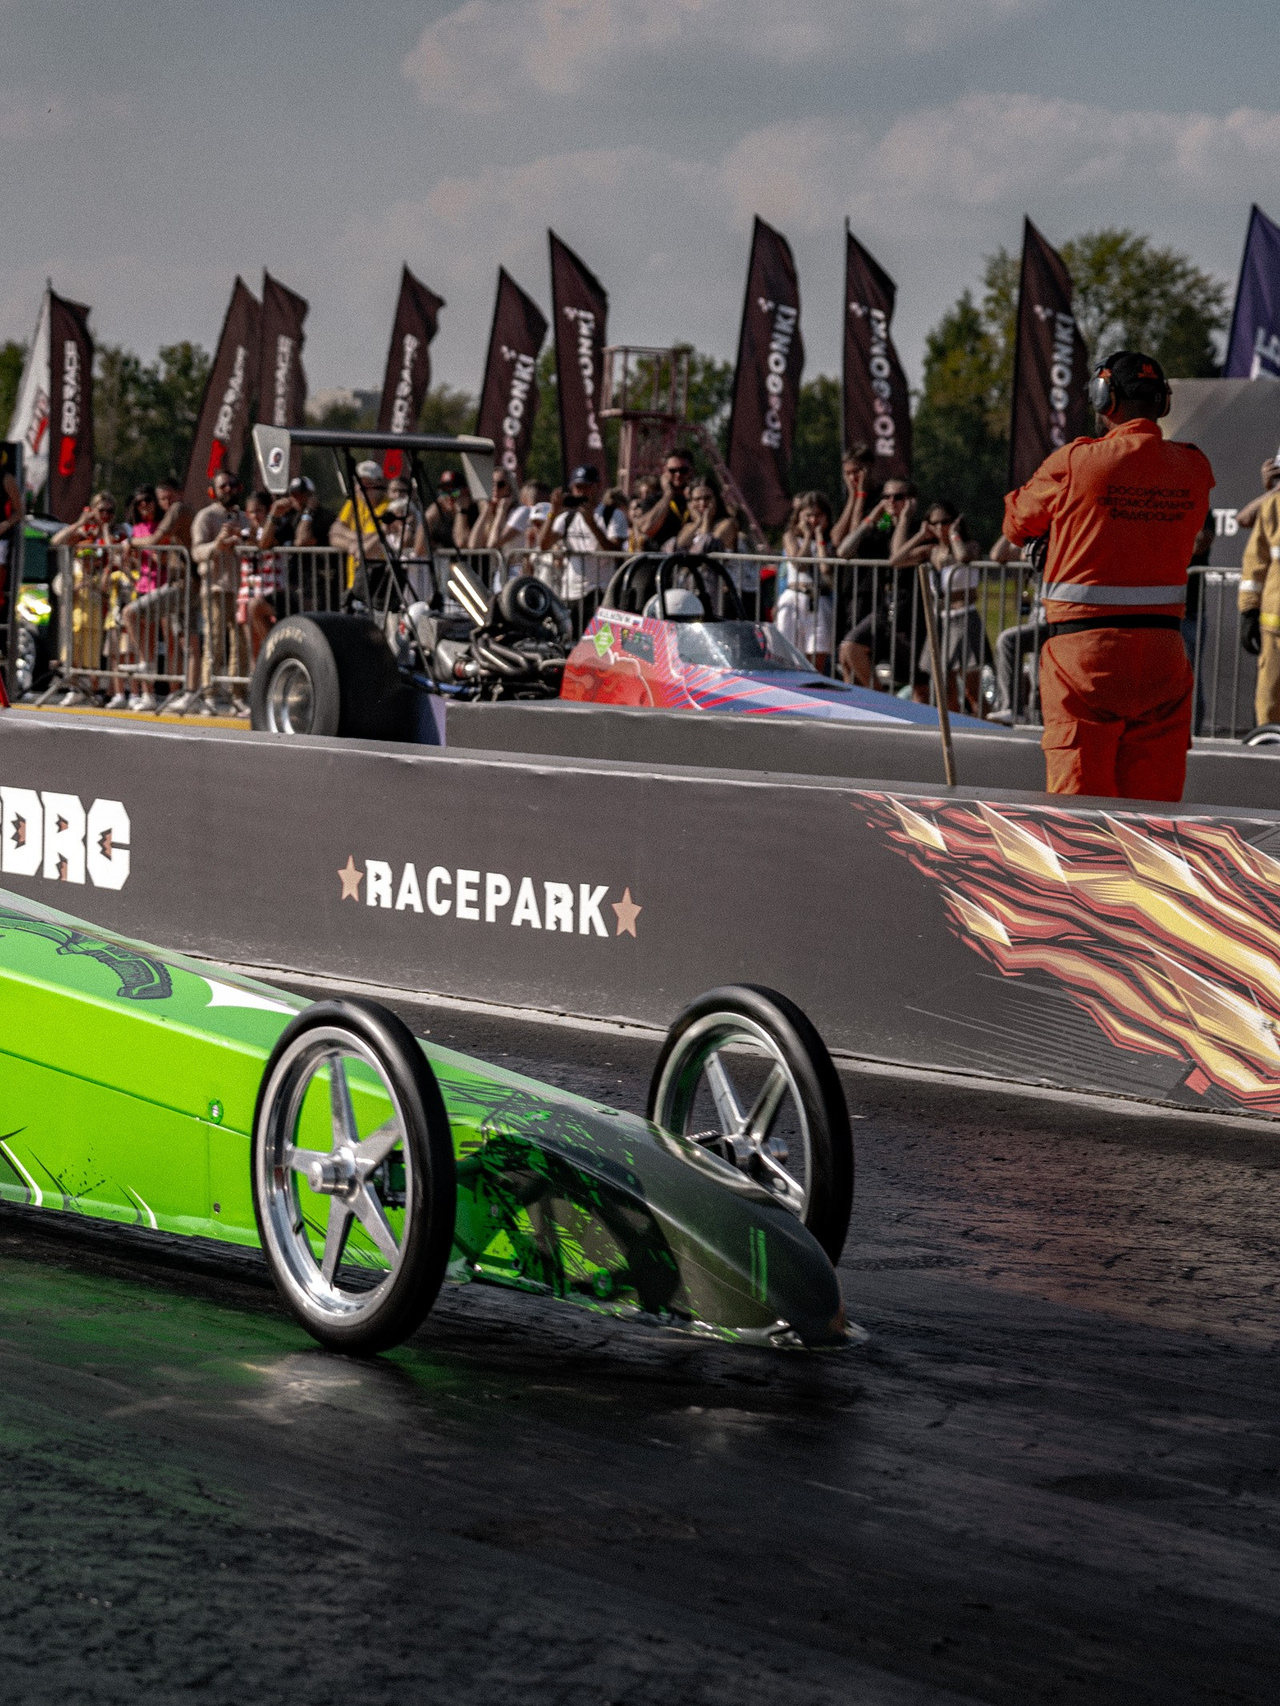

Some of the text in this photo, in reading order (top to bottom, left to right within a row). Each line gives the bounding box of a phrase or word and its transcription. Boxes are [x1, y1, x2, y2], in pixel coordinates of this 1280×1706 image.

[502, 353, 535, 478] OSGONKI
[870, 308, 895, 457] ROSGONKI
[1050, 312, 1075, 449] OSGONKI
[1211, 508, 1239, 536] ТБ
[365, 859, 609, 937] RACEPARK
